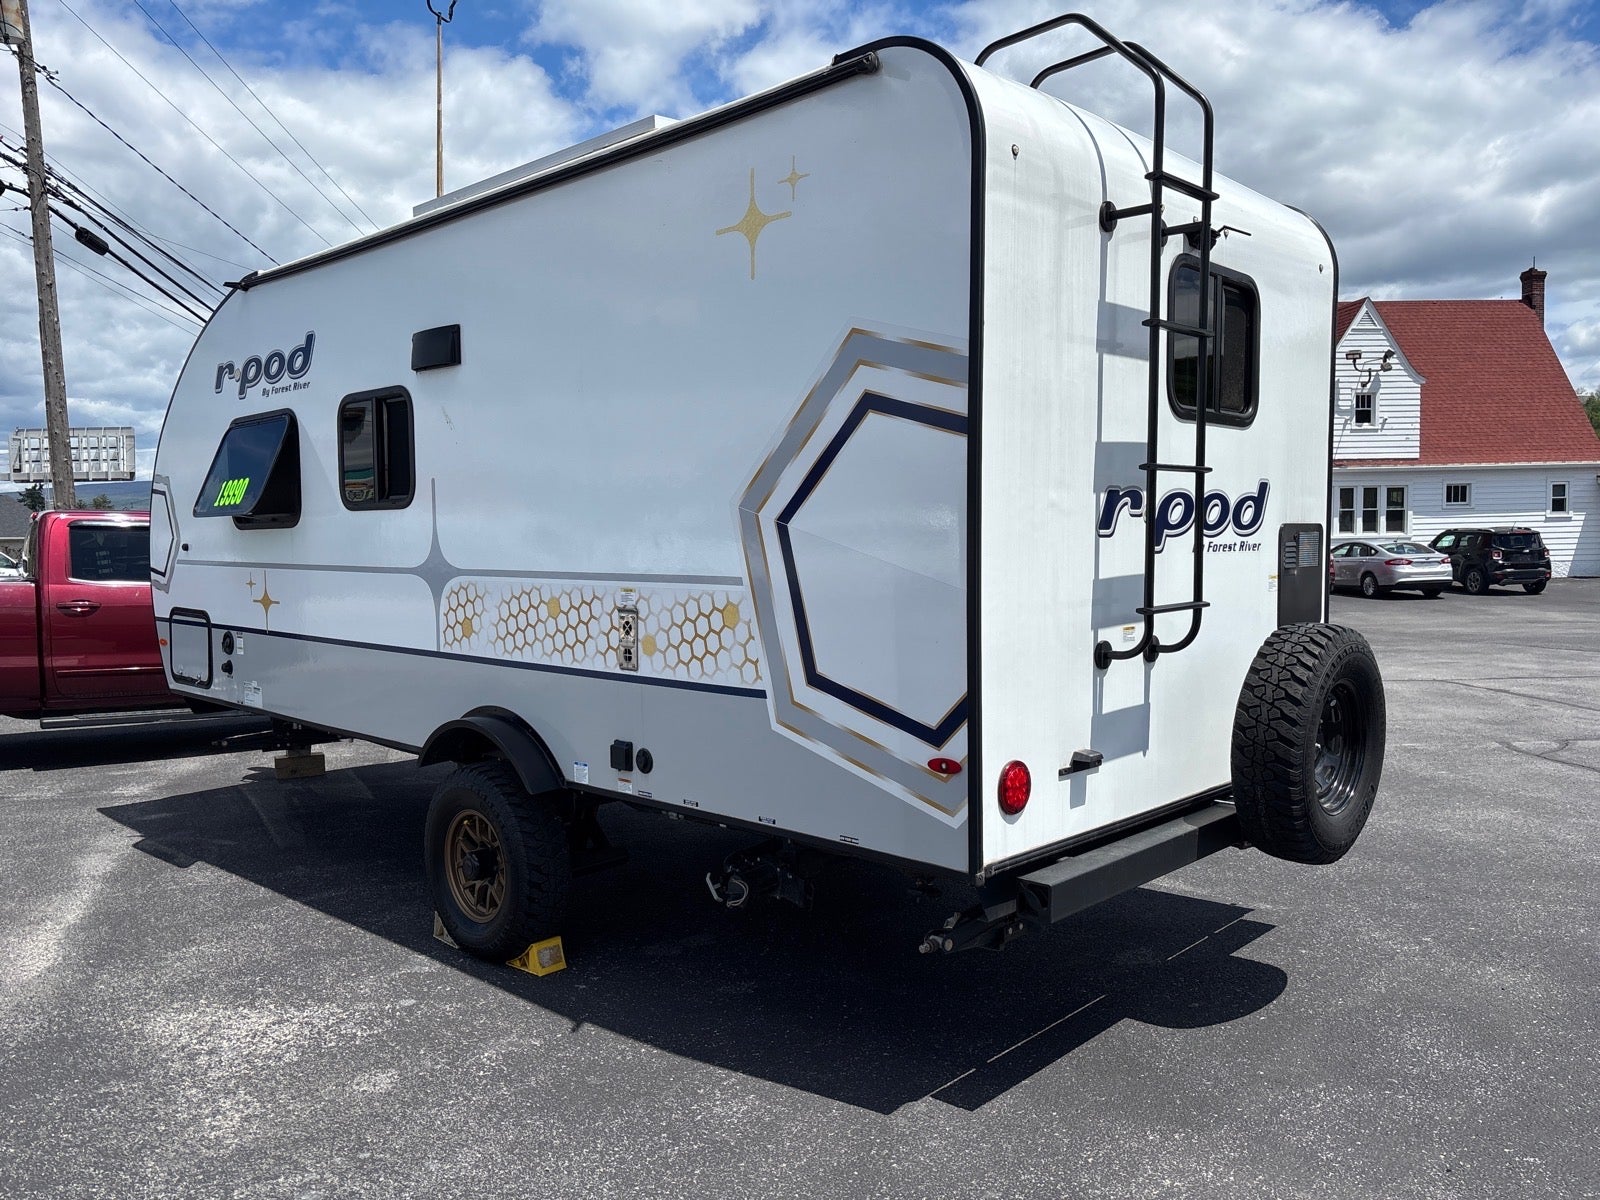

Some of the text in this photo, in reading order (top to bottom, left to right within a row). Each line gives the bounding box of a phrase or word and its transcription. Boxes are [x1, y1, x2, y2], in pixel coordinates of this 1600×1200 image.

[262, 381, 311, 398] By Forest River
[213, 477, 250, 507] 19990
[1207, 541, 1237, 553] Forest
[1239, 540, 1262, 552] River
